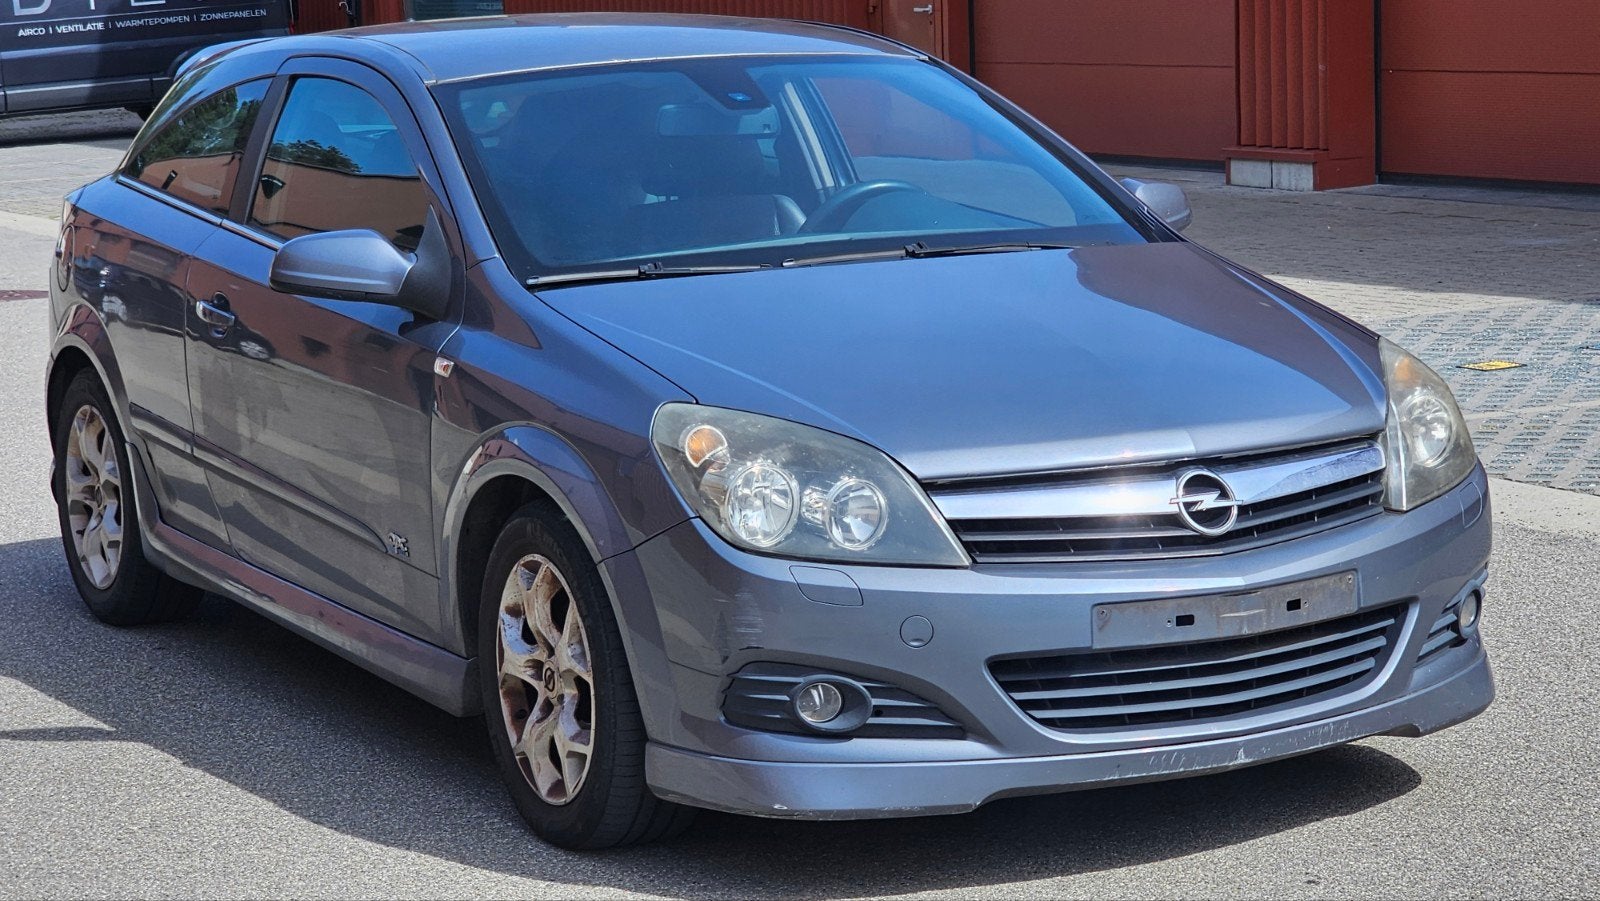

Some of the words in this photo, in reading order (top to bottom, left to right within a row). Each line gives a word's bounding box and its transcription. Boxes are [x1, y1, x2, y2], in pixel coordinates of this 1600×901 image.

[17, 27, 46, 37] AIRCO
[55, 22, 105, 34] VENTILATIE
[115, 15, 190, 28] WARMTEPOMPEN
[200, 9, 267, 21] ZONNEPANELEN
